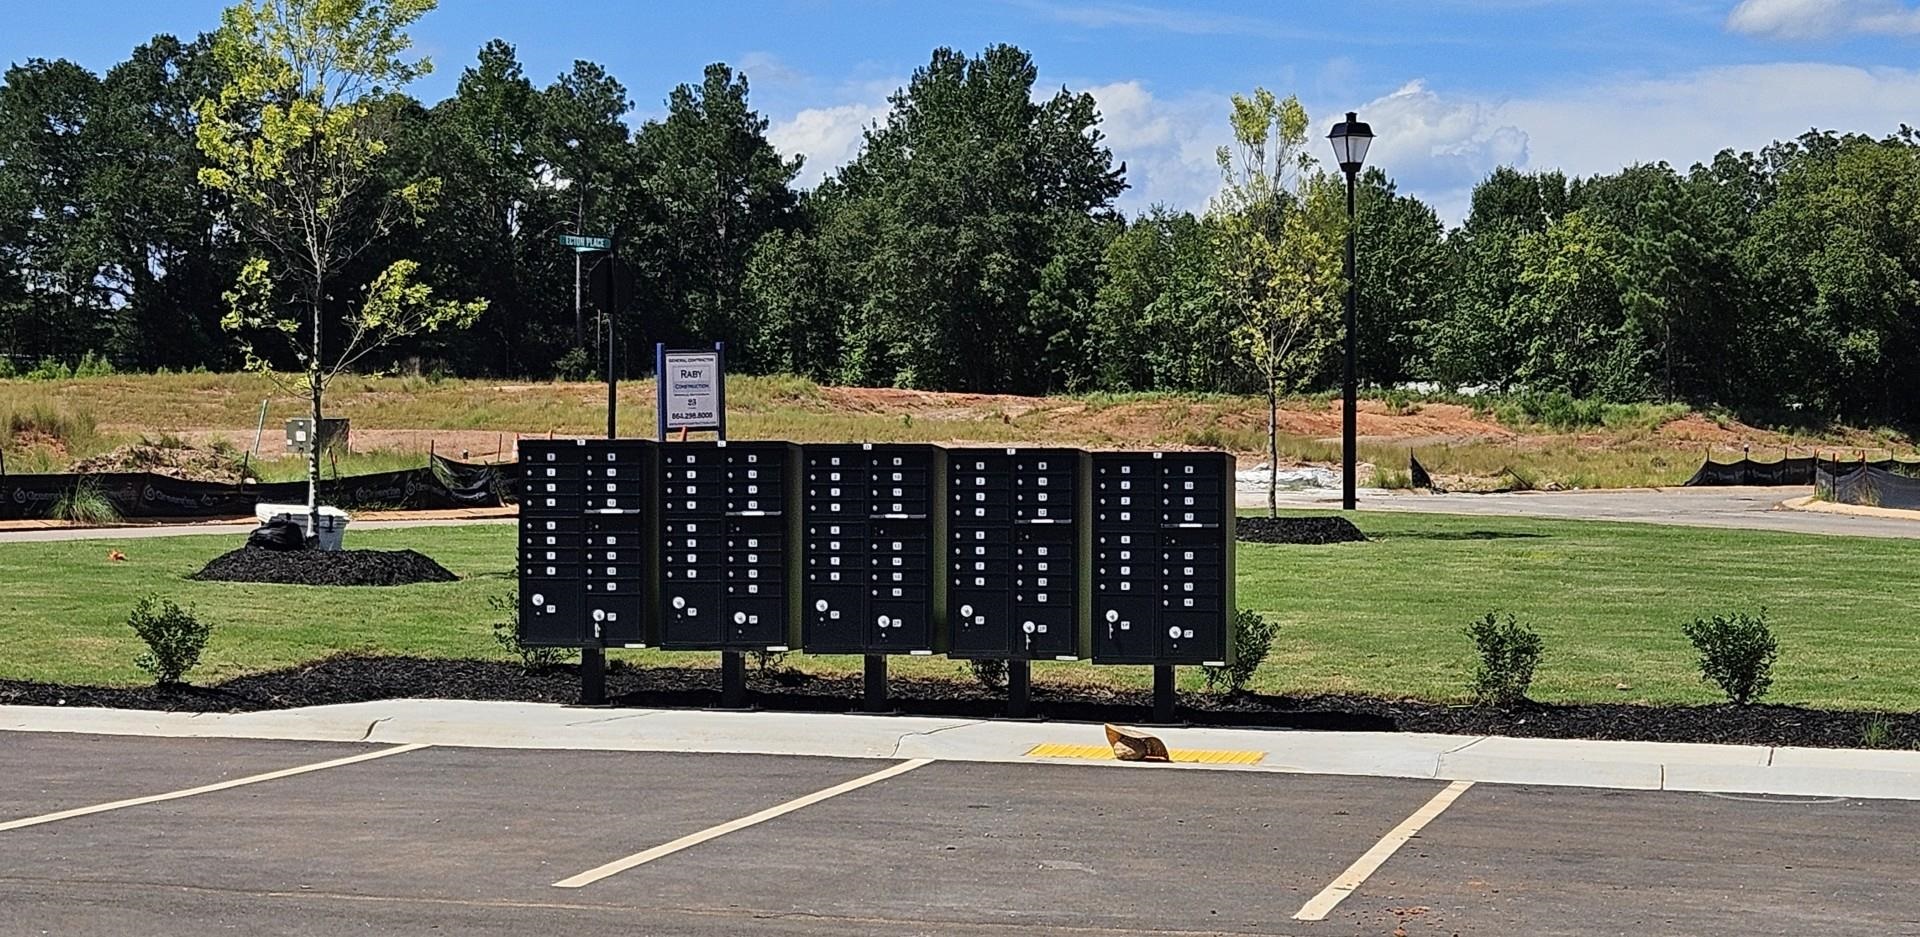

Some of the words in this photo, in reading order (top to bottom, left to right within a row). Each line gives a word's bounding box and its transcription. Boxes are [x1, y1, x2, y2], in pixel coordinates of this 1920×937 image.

[566, 236, 585, 246] ECTON
[586, 237, 604, 248] PLACE
[680, 370, 703, 379] RABY
